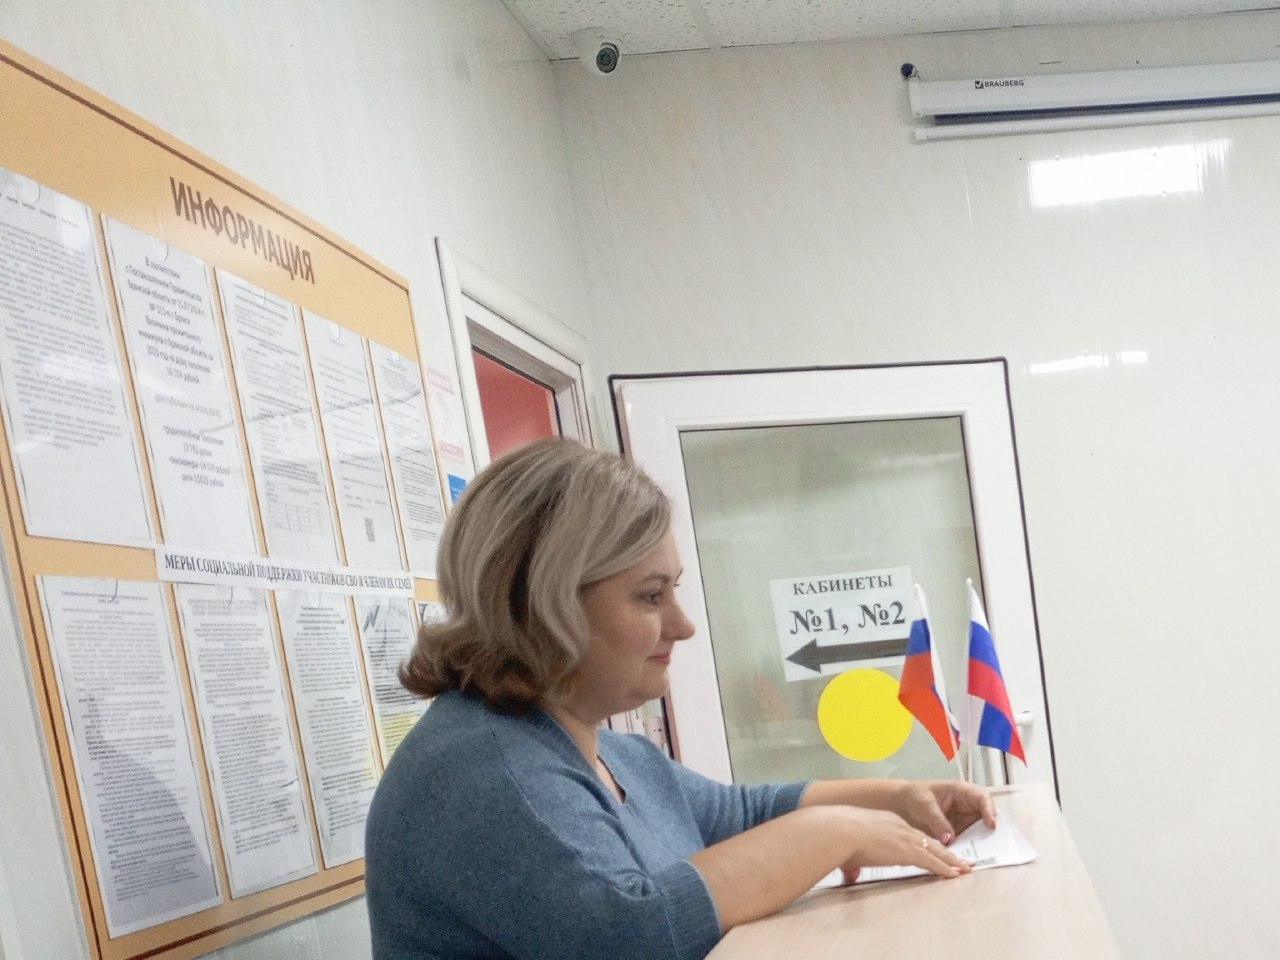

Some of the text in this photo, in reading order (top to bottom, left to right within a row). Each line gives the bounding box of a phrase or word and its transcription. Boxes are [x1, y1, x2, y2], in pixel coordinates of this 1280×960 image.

[985, 79, 1024, 88] BRAUBERG
[170, 177, 316, 285] ИНФОРМАЦИЯ
[165, 554, 195, 571] МЕРЫ
[196, 557, 255, 577] СОЦИАЛЬНОЙ
[256, 564, 302, 583] ПОДДЕРЖКИ
[346, 574, 358, 587] СВО
[793, 575, 893, 596] КАБИНЕТЫ
[789, 600, 906, 635] №1, №2
